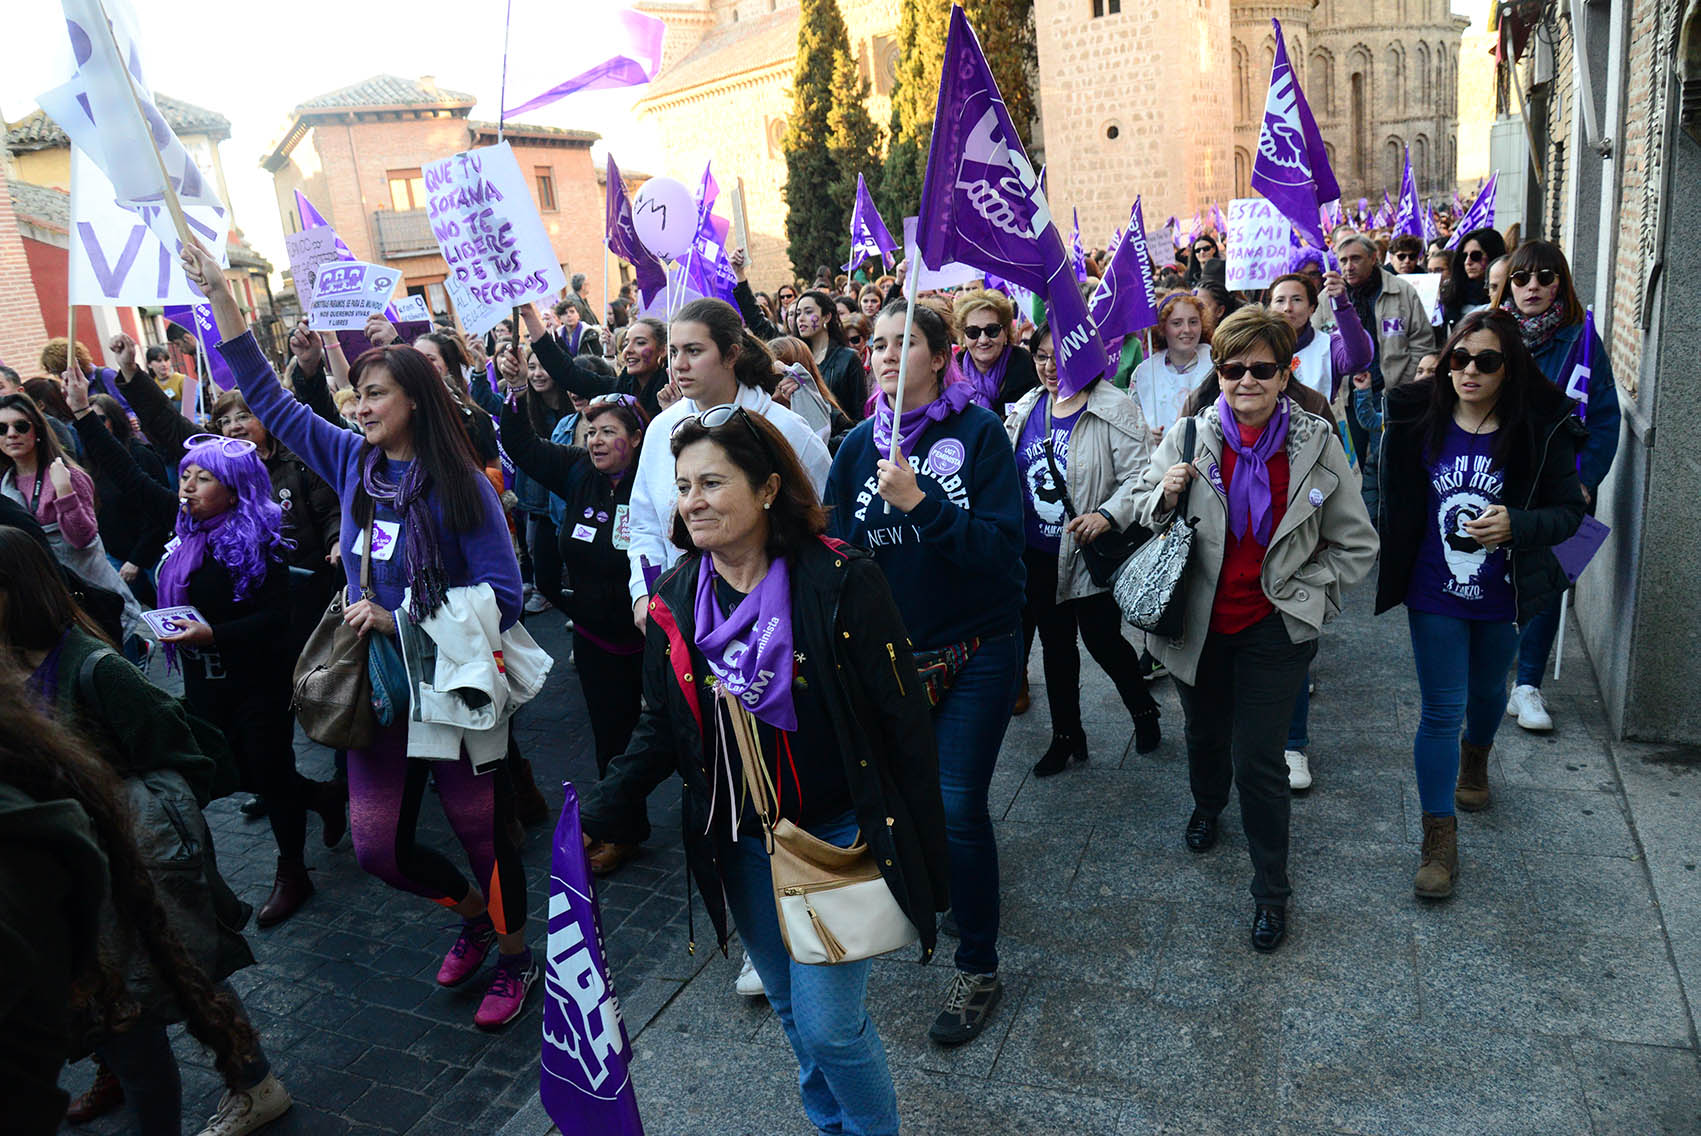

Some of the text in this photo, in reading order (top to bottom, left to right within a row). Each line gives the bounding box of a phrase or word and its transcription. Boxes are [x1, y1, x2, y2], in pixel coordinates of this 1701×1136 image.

[425, 155, 482, 192] QUE TU
[429, 178, 504, 219] SOTANA
[1229, 201, 1272, 220] ESTA
[434, 207, 494, 243] NO TE
[1228, 225, 1282, 243] ES MI
[444, 222, 518, 264] LIBERE
[456, 250, 522, 281] DE TUS
[1227, 266, 1247, 281] NO
[1248, 261, 1267, 281] ES
[470, 269, 550, 305] PECADOS
[1455, 456, 1492, 473] NI UN
[1433, 471, 1503, 498] PASO ATRA
[867, 526, 902, 548] NEW
[757, 617, 780, 660] minista
[741, 669, 775, 705] 8M
